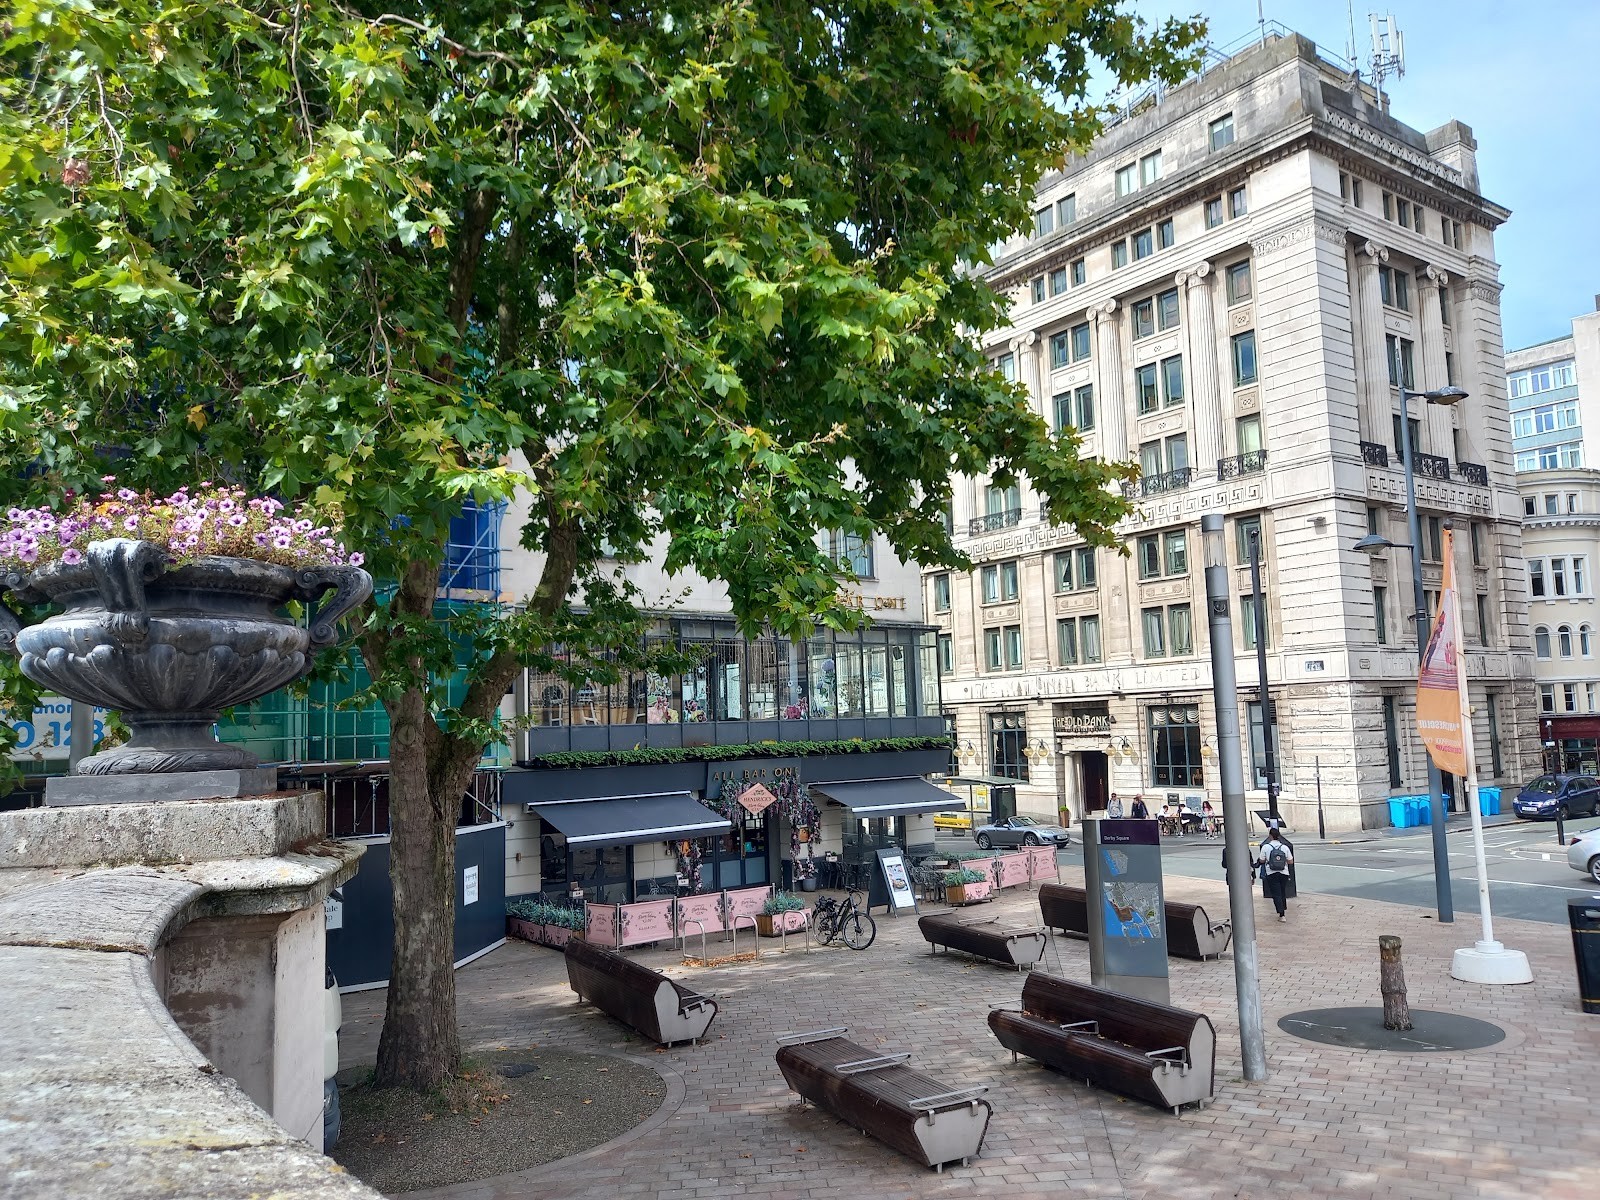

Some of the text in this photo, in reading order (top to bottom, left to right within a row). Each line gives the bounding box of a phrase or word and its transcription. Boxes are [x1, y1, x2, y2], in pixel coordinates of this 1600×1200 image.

[1136, 667, 1200, 685] LIMITED
[1053, 714, 1108, 728] THE OLD BANK
[714, 769, 736, 781] ALL
[744, 767, 767, 779] BAR
